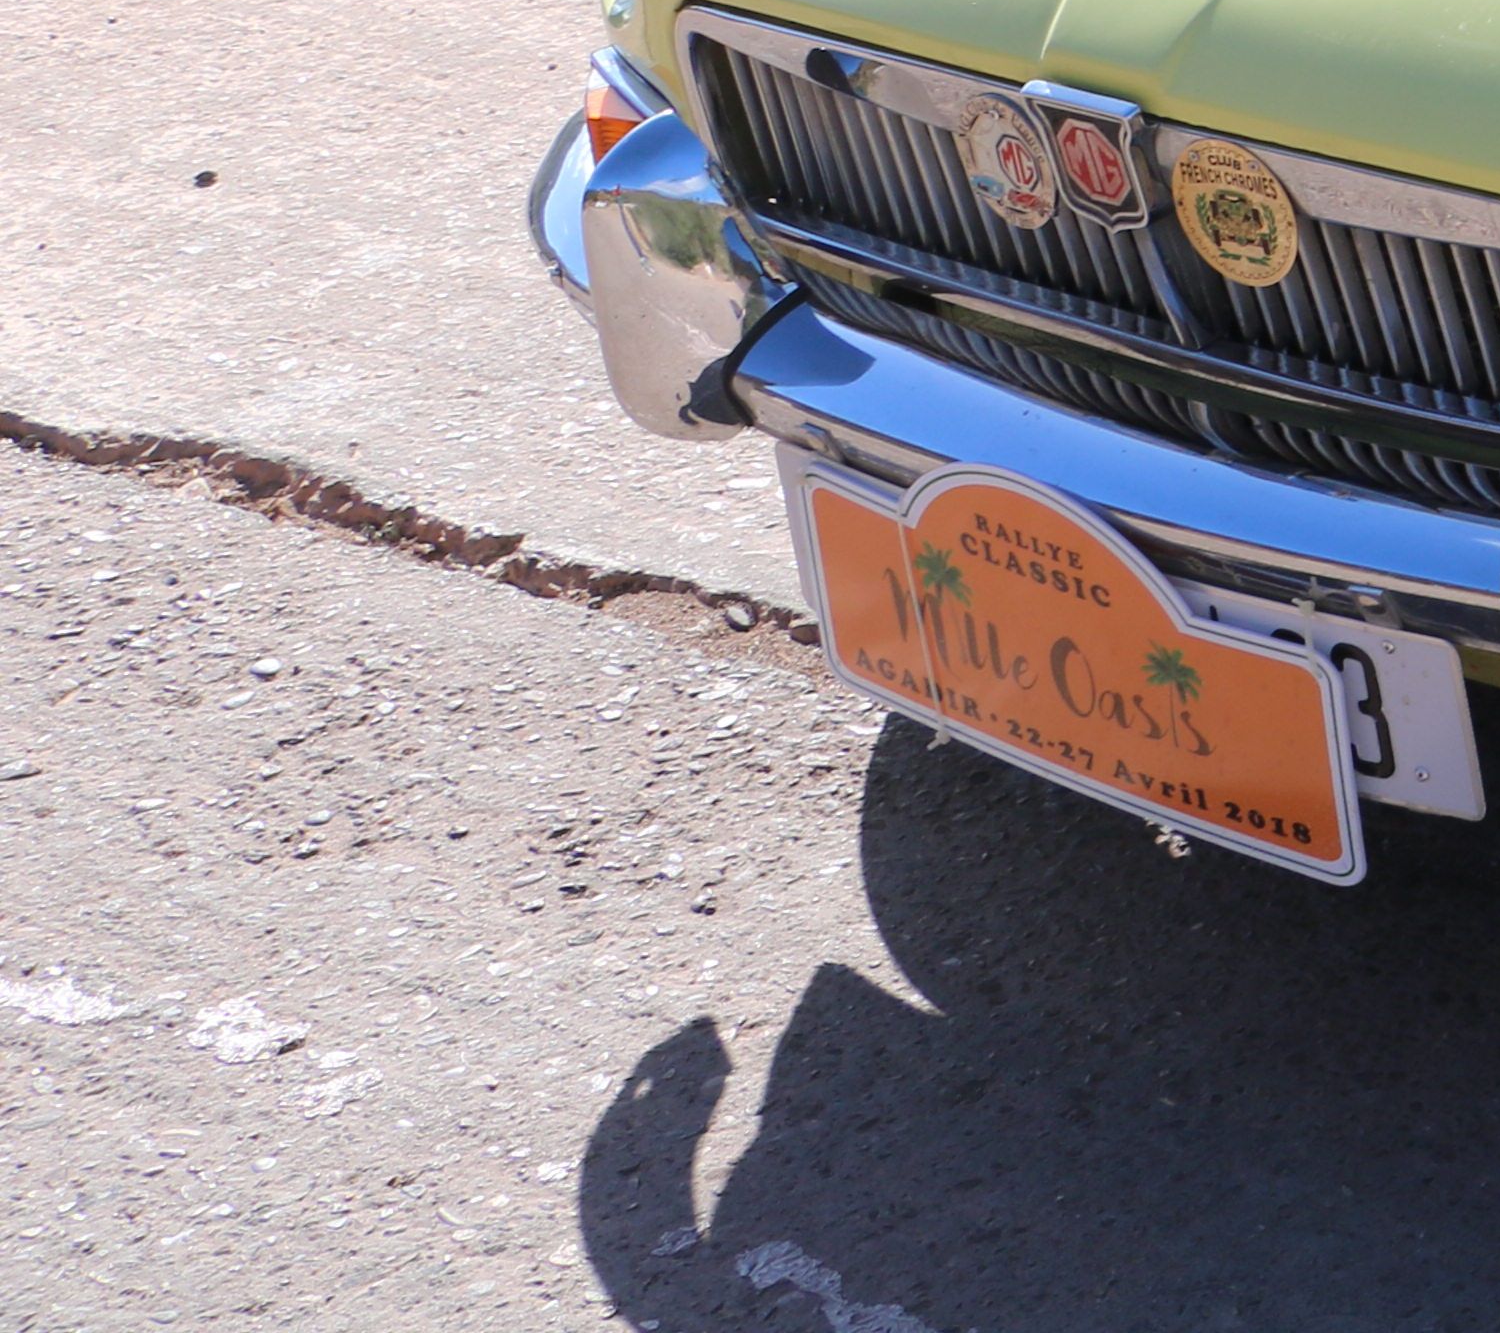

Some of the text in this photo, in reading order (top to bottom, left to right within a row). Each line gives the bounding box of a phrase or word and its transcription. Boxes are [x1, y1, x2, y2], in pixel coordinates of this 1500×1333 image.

[1000, 139, 1037, 189] MG
[1062, 125, 1126, 199] MG
[1179, 161, 1279, 200] FRENCH CHROMES
[1207, 154, 1242, 171] CLUB
[959, 532, 1112, 609] CLASSIC
[974, 513, 1084, 571] RALLYE
[1049, 635, 1217, 757] Oasis
[1113, 758, 1209, 811] Avril
[1223, 800, 1312, 845] 2018
